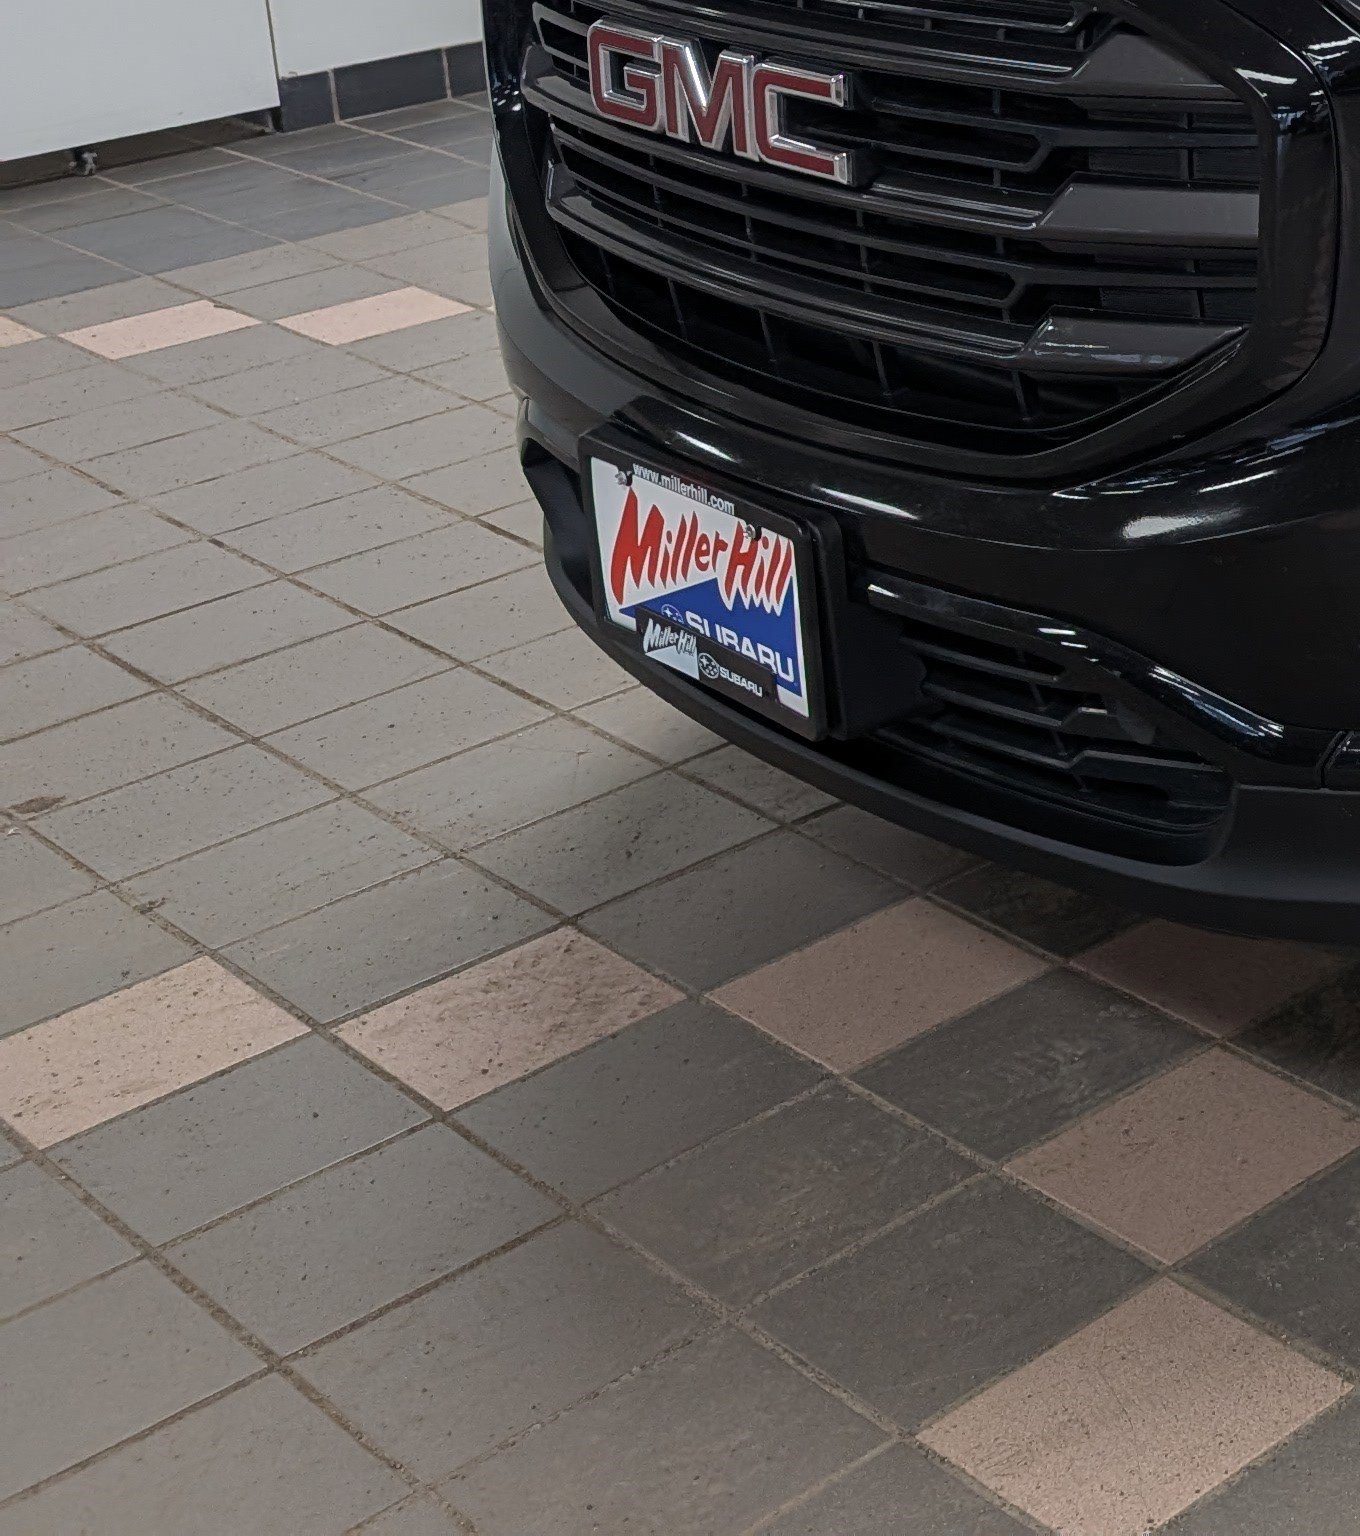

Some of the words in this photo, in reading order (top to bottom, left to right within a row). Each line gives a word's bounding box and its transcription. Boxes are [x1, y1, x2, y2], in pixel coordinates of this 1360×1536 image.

[587, 21, 850, 186] GMC
[632, 463, 736, 516] www.millerhill.com
[719, 666, 764, 698] SUBARU
